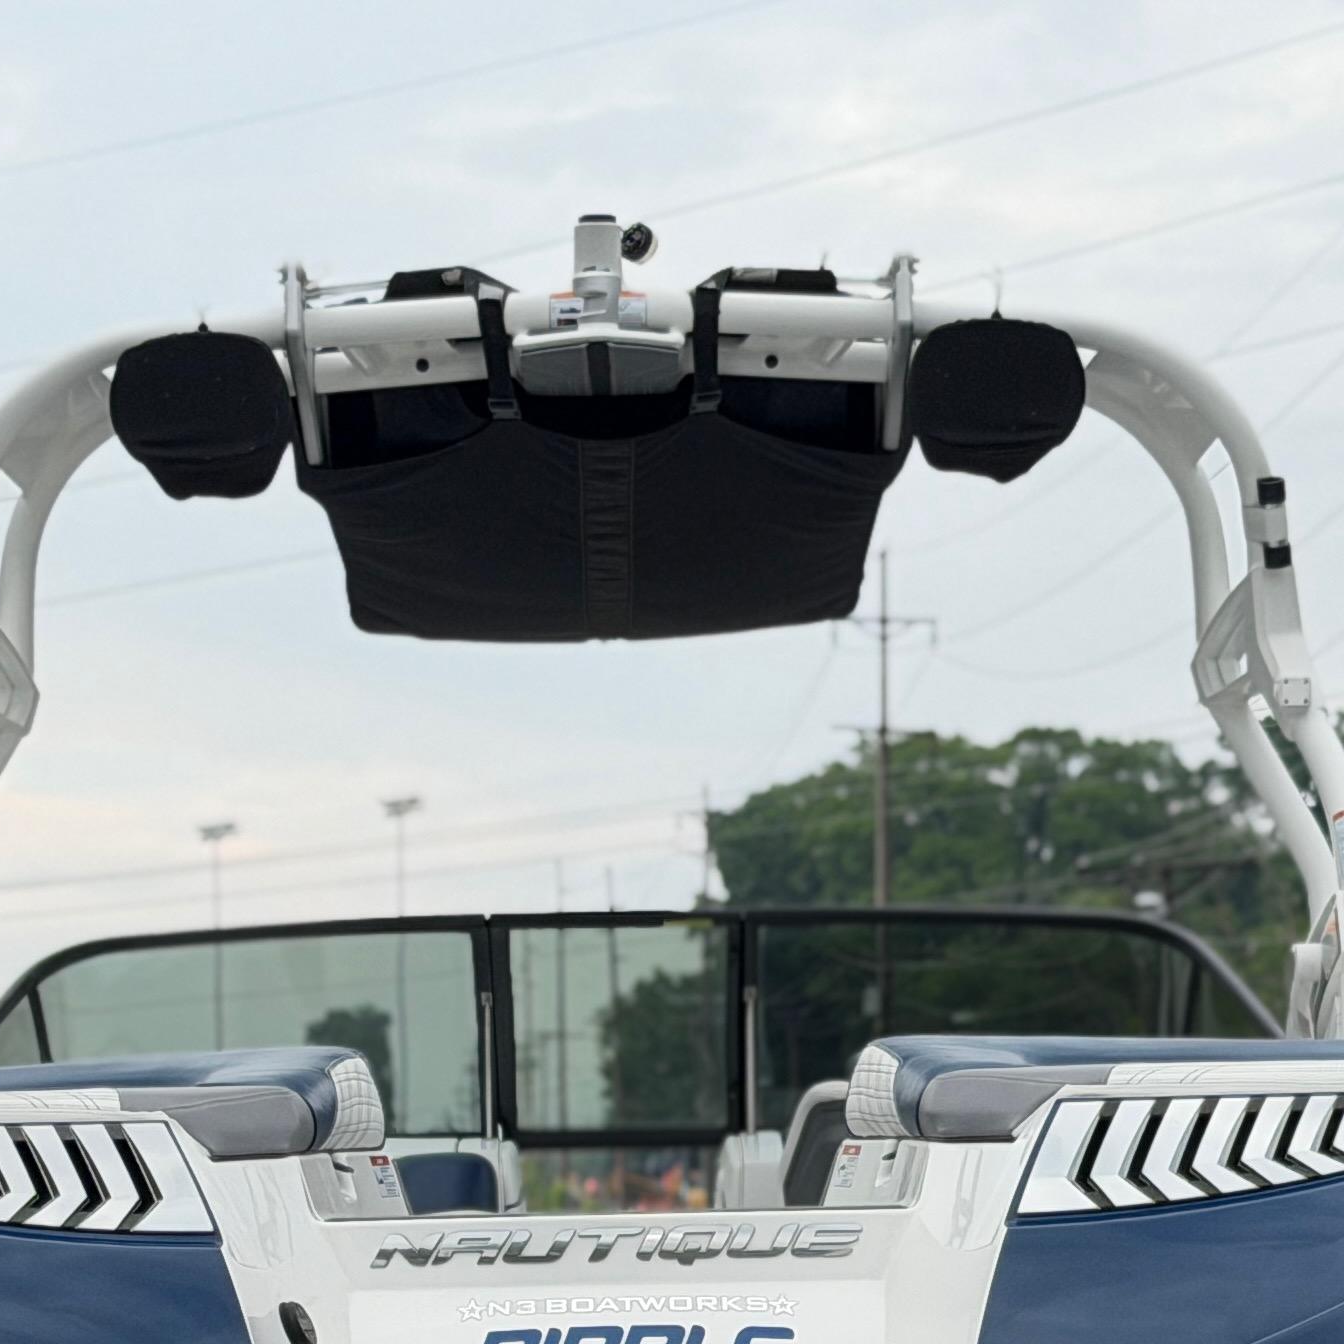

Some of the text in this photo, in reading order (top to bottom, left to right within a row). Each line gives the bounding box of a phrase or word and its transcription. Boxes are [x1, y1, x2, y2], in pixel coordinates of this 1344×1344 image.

[370, 1222, 864, 1269] NAUTIQUE
[488, 1296, 768, 1316] N3 BOATWORKS
